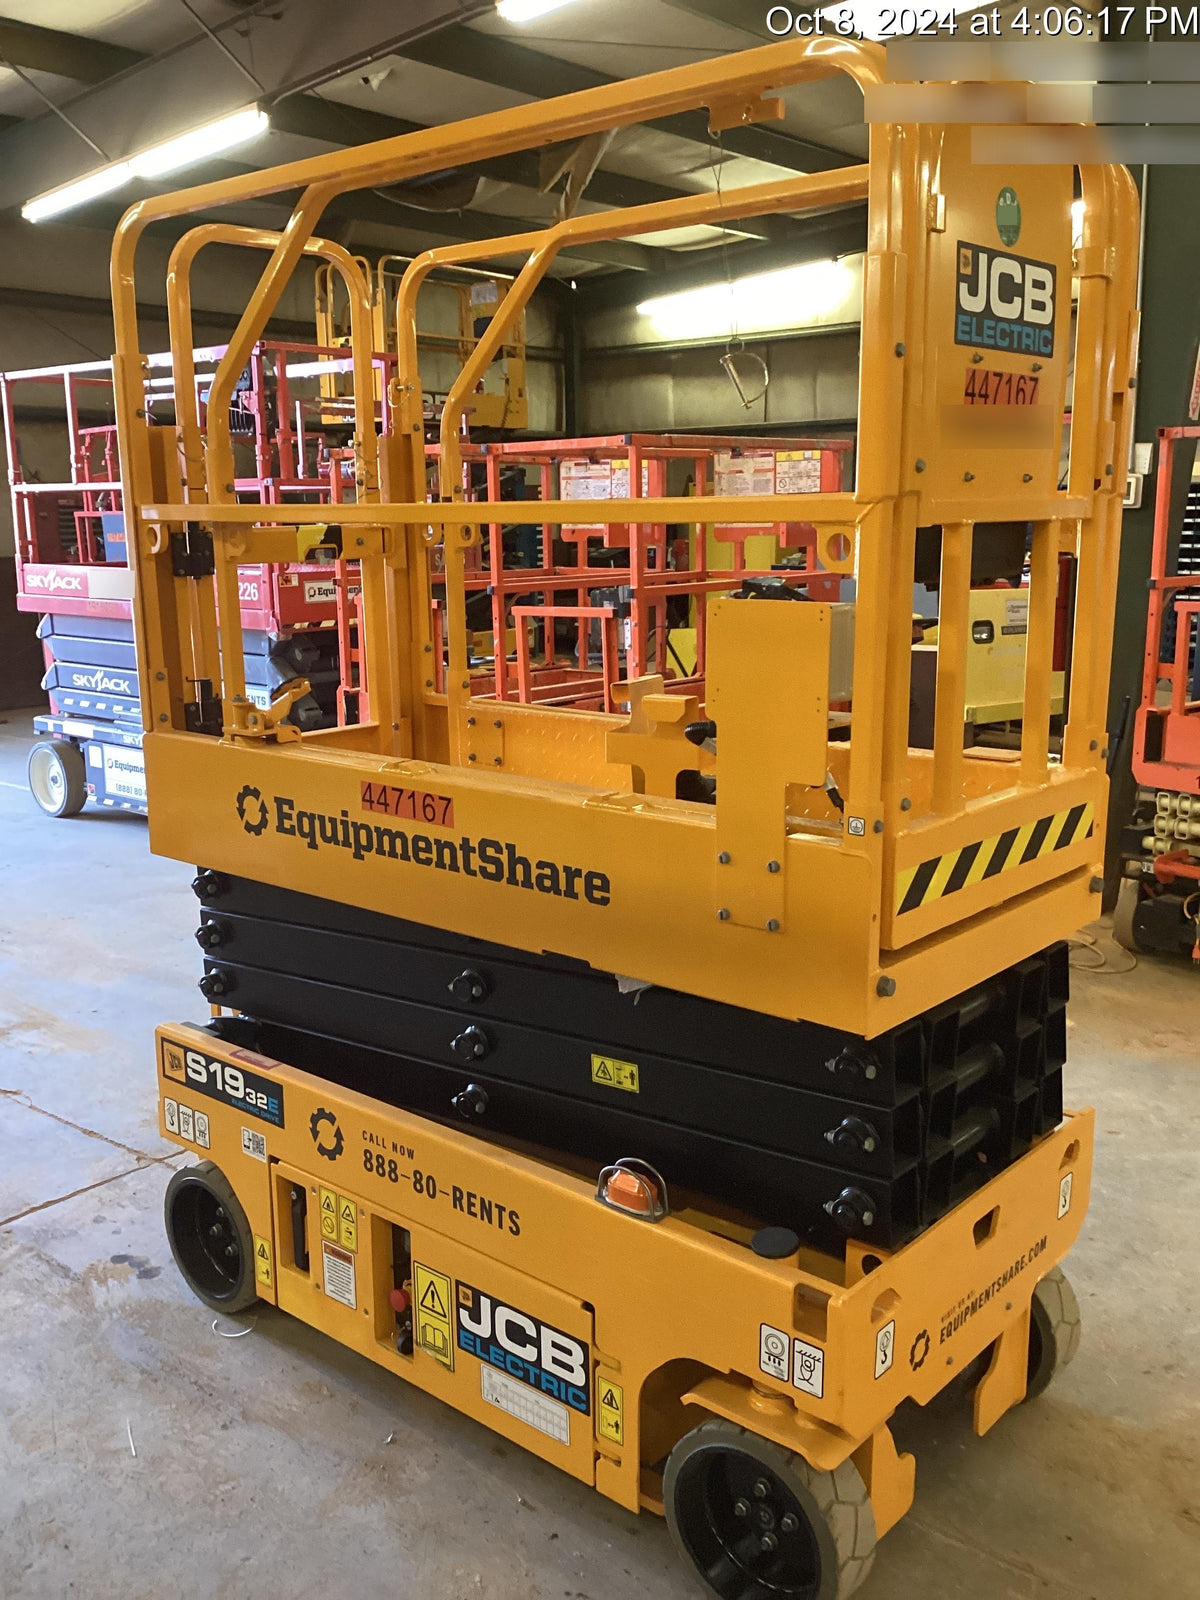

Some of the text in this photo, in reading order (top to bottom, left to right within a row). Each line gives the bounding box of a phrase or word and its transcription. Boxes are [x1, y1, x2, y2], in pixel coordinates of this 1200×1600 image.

[959, 252, 1054, 325] JCB
[957, 315, 1053, 355] ELECTRIC
[964, 368, 1039, 405] 447167
[26, 569, 82, 591] SKYJACK
[72, 670, 131, 694] SKYJACK
[361, 783, 452, 825] 447167
[274, 796, 611, 907] EquipmentShare
[362, 1130, 415, 1160] CALL NOW
[363, 1148, 521, 1237] 888-80-RENTS
[940, 1235, 1047, 1344] EQUIPMENTSHARE.COM
[459, 1295, 586, 1387] JCB
[459, 1329, 587, 1412] ELECTRIC
